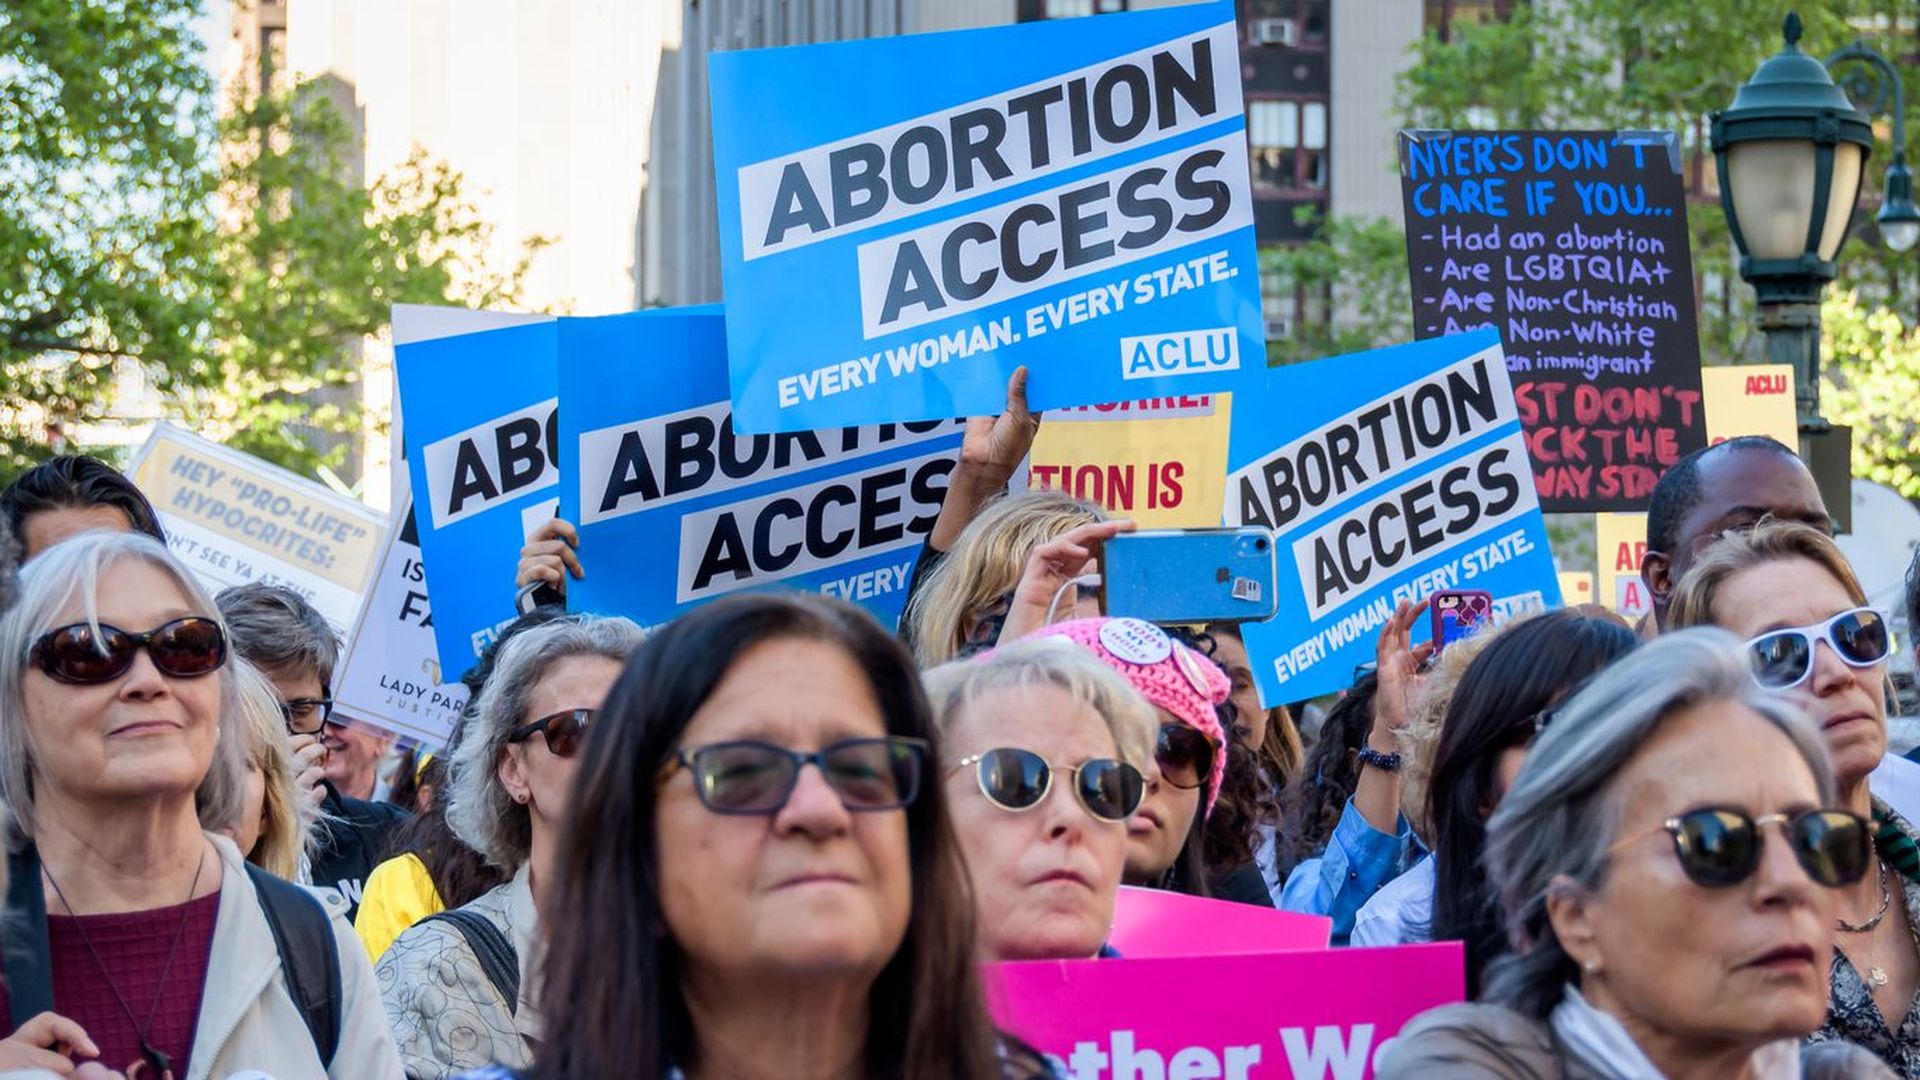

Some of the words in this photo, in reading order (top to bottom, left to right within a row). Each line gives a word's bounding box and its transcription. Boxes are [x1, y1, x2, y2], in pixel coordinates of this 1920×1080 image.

[763, 37, 1217, 247] ABORTION
[1409, 135, 1525, 180] NYER'S
[1533, 137, 1653, 173] DON'T
[1413, 178, 1509, 217] CARE
[1524, 181, 1556, 216] IF
[1574, 181, 1672, 216] YOU...
[879, 150, 1232, 325] ACCESS
[1441, 224, 1500, 250] Had
[1509, 231, 1545, 250] an
[1556, 223, 1665, 254] abortion
[1441, 258, 1490, 282] Are
[1505, 254, 1672, 285] LGBTQIA+
[1440, 287, 1495, 313] Are
[1506, 286, 1677, 321] Non-Christian
[779, 353, 884, 408] EVERY
[886, 316, 1021, 378] WOMAN.
[1026, 279, 1130, 338] EVERY
[1134, 251, 1239, 305] STATE.
[1508, 317, 1655, 347] Non-White
[1128, 332, 1232, 375] ACLU
[1537, 350, 1655, 380] immigrant
[1745, 374, 1787, 395] ACLU
[1574, 384, 1700, 427] DON'T
[1238, 359, 1498, 530] ABORTION
[1522, 425, 1587, 463] CK
[1592, 426, 1680, 465] THE
[170, 455, 226, 488] HEY
[1028, 464, 1135, 511] TION
[1147, 461, 1184, 509] IS
[172, 486, 336, 569] HYPOCRITES:
[1315, 448, 1520, 609] ACCESS
[200, 546, 230, 569] SEE
[235, 560, 254, 580] YA
[402, 558, 424, 582] IS
[1273, 633, 1328, 684] EVERY
[1462, 528, 1534, 580] STATE.
[380, 674, 427, 699] LADY
[1043, 1030, 1262, 1080] ther
